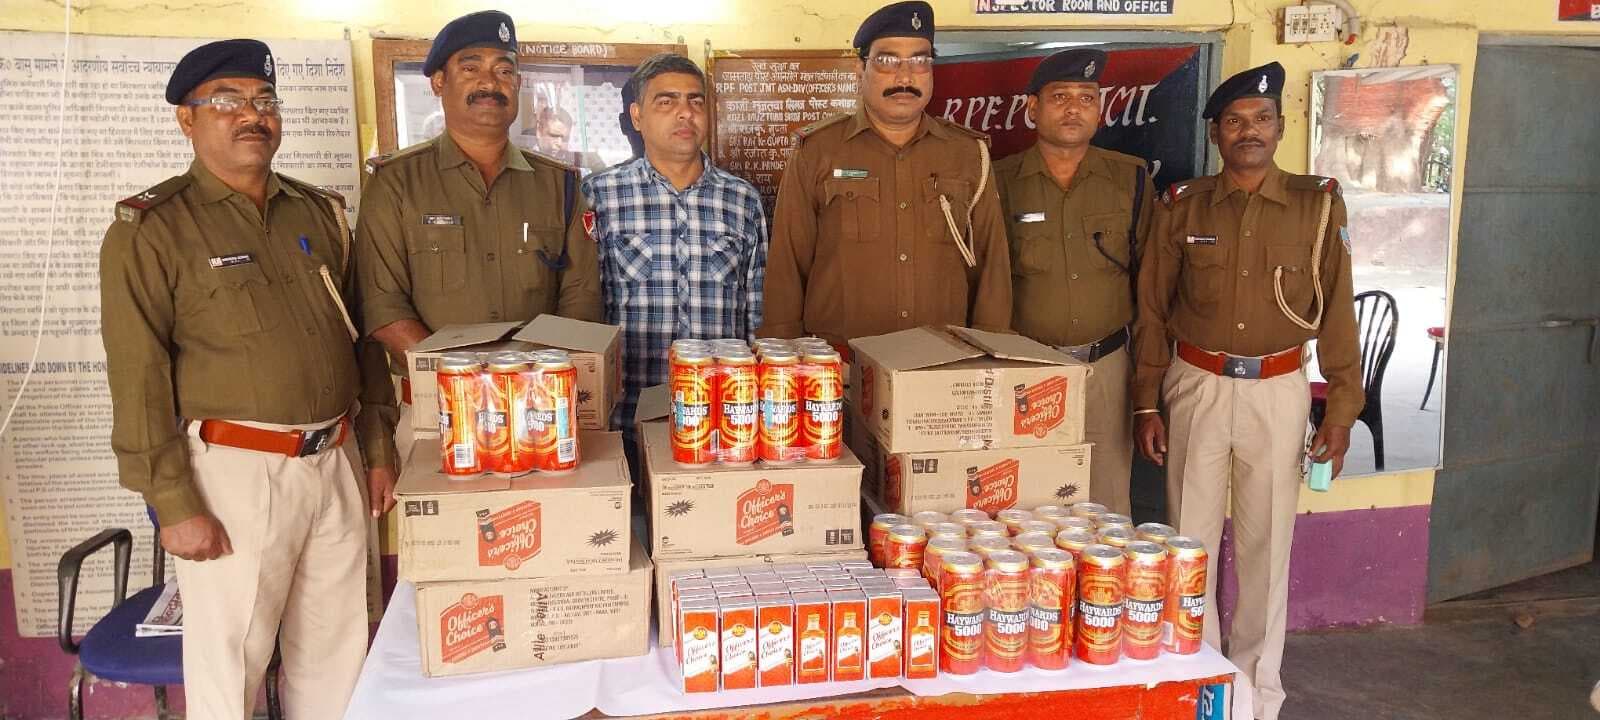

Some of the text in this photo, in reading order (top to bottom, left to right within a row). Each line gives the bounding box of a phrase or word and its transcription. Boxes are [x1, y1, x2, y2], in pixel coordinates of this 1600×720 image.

[1063, 0, 1092, 11] ROOM
[1097, 0, 1120, 12] AND
[1124, 0, 1168, 13] OFFICE
[803, 112, 820, 120] POST
[47, 361, 66, 373] DOWN
[79, 361, 91, 373] THE
[983, 475, 1014, 492] Choice
[743, 491, 786, 514] Officer's
[741, 510, 775, 528] Choice
[499, 518, 538, 538] Choice
[1080, 600, 1121, 617] HAYWARDS
[1085, 613, 1115, 627] 5000
[1128, 610, 1158, 622] 5000
[955, 624, 982, 636] 5000
[998, 622, 1025, 634] 5000
